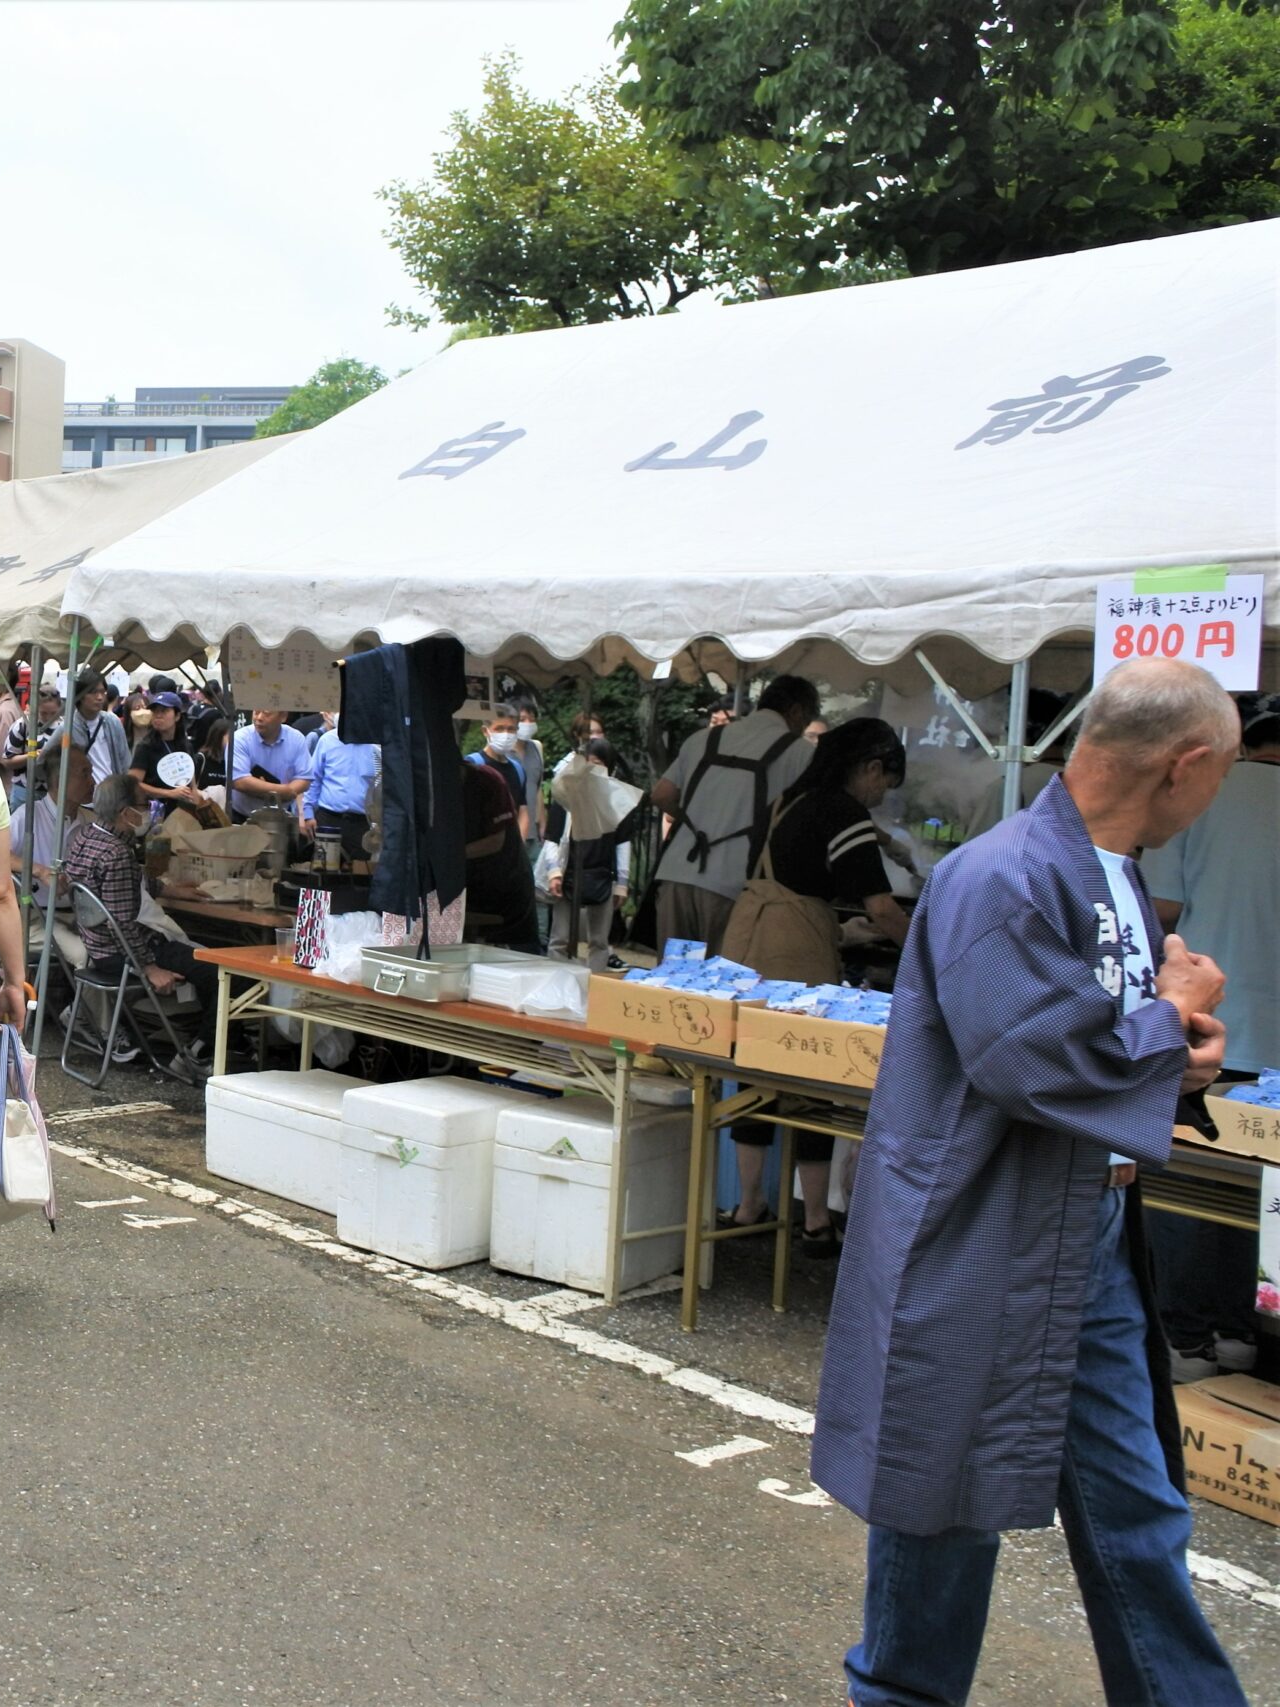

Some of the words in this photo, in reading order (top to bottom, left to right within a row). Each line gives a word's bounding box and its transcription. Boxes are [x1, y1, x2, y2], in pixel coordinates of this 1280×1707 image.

[1093, 902, 1122, 997] 白山
[622, 1002, 664, 1025] とら豆
[777, 1031, 837, 1058] 金時豆
[1227, 1466, 1271, 1491] 84本
